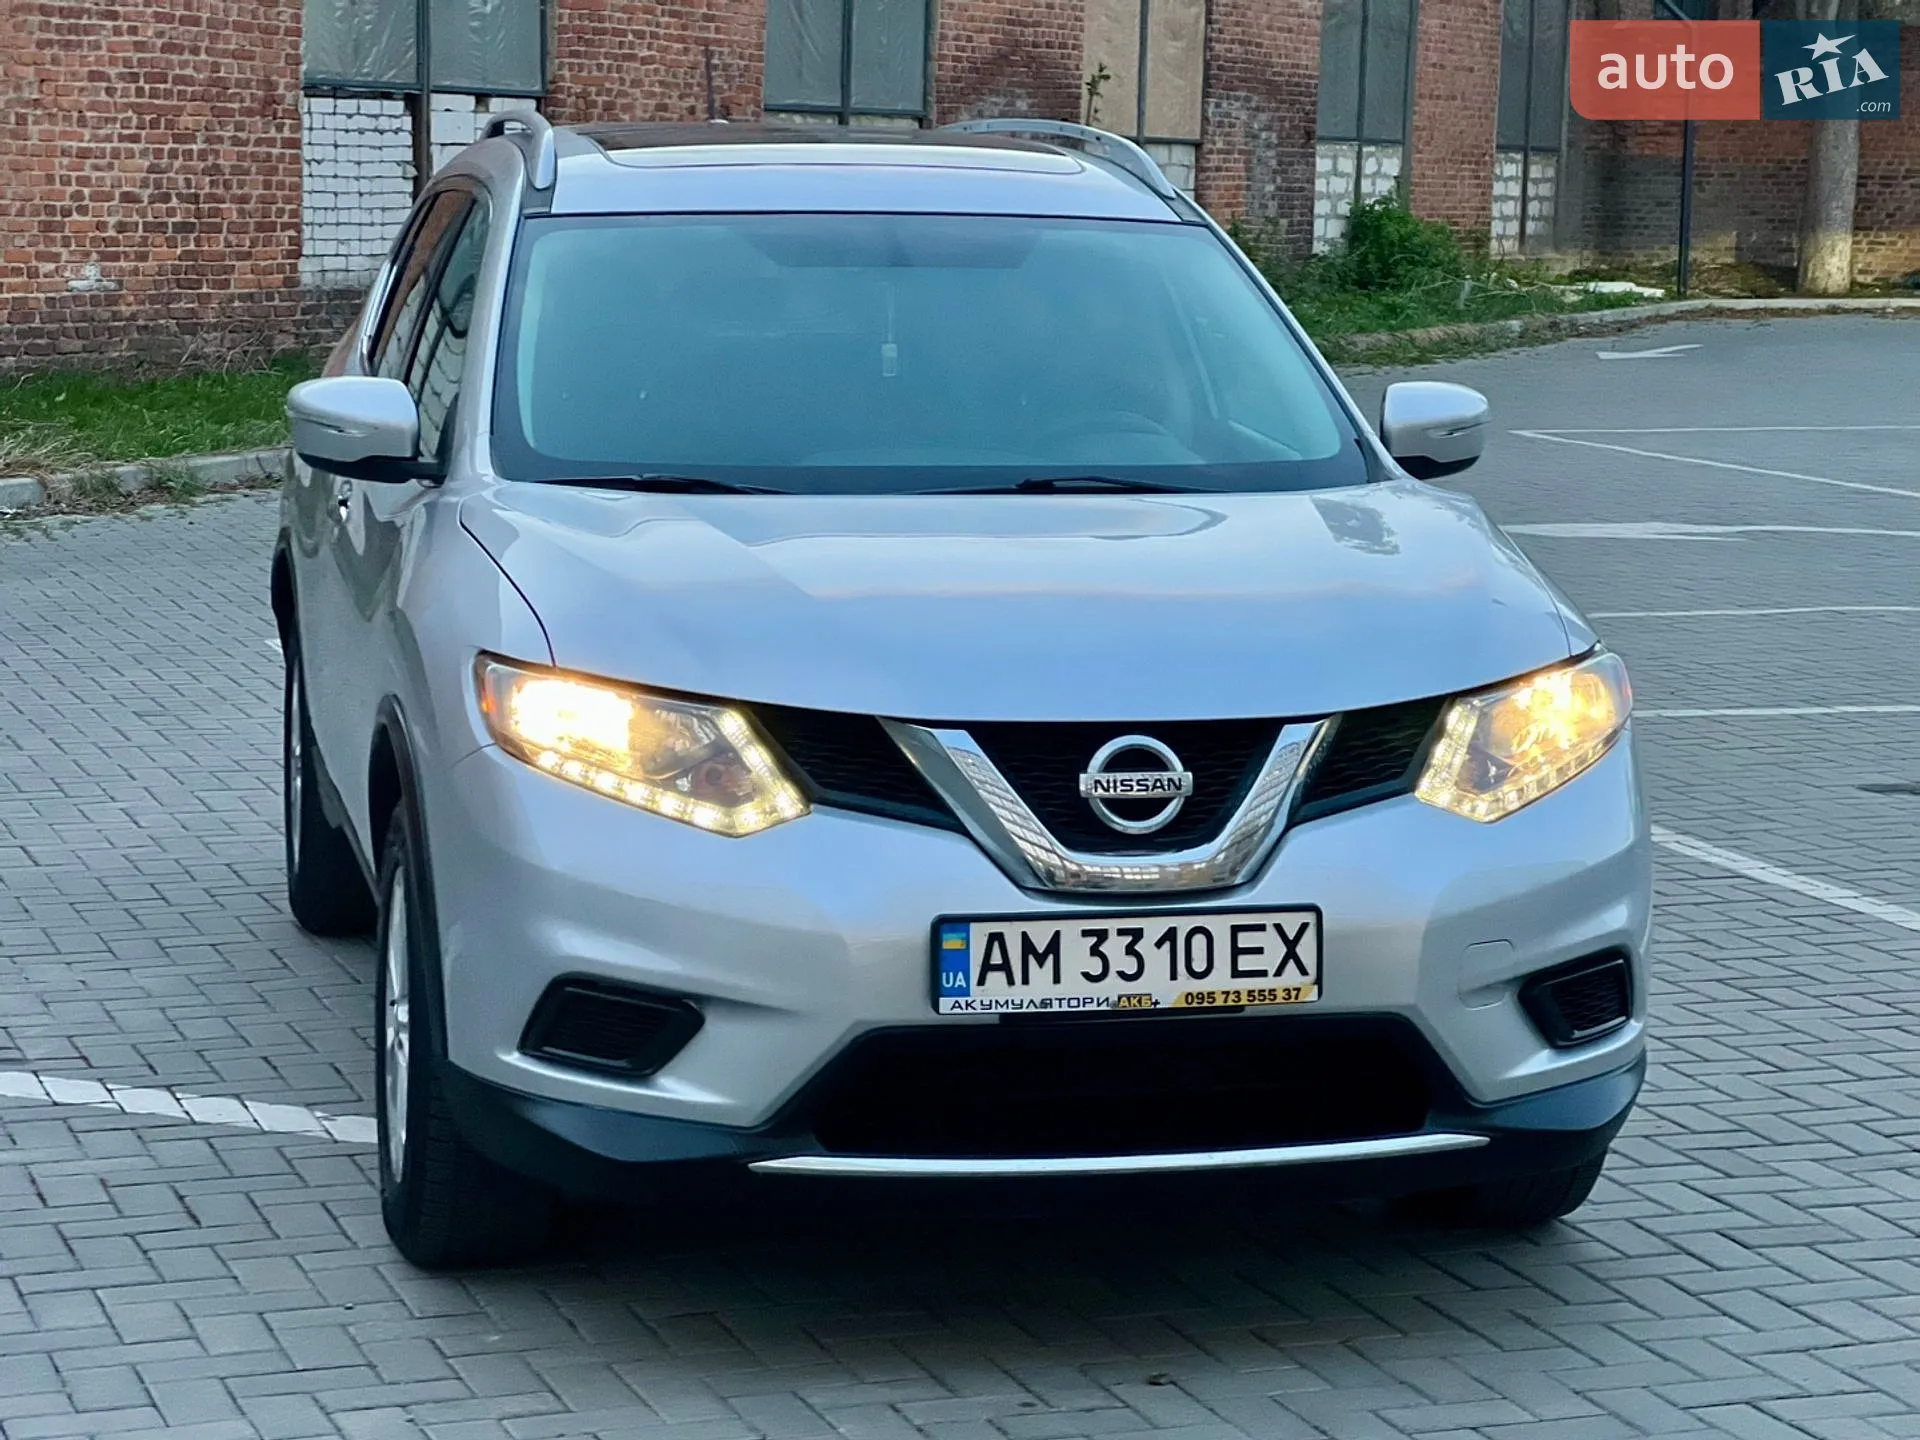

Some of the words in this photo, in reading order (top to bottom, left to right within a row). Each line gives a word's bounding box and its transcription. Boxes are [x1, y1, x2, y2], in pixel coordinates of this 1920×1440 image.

[1093, 777, 1182, 793] NISSAN
[976, 929, 1061, 987] AM
[1080, 925, 1214, 983] 3310
[1230, 921, 1311, 979] EX
[941, 972, 966, 989] UA
[1185, 991, 1217, 1006] 095
[1221, 990, 1242, 1004] 73
[1247, 988, 1278, 1003] 555
[1282, 987, 1302, 1001] 37
